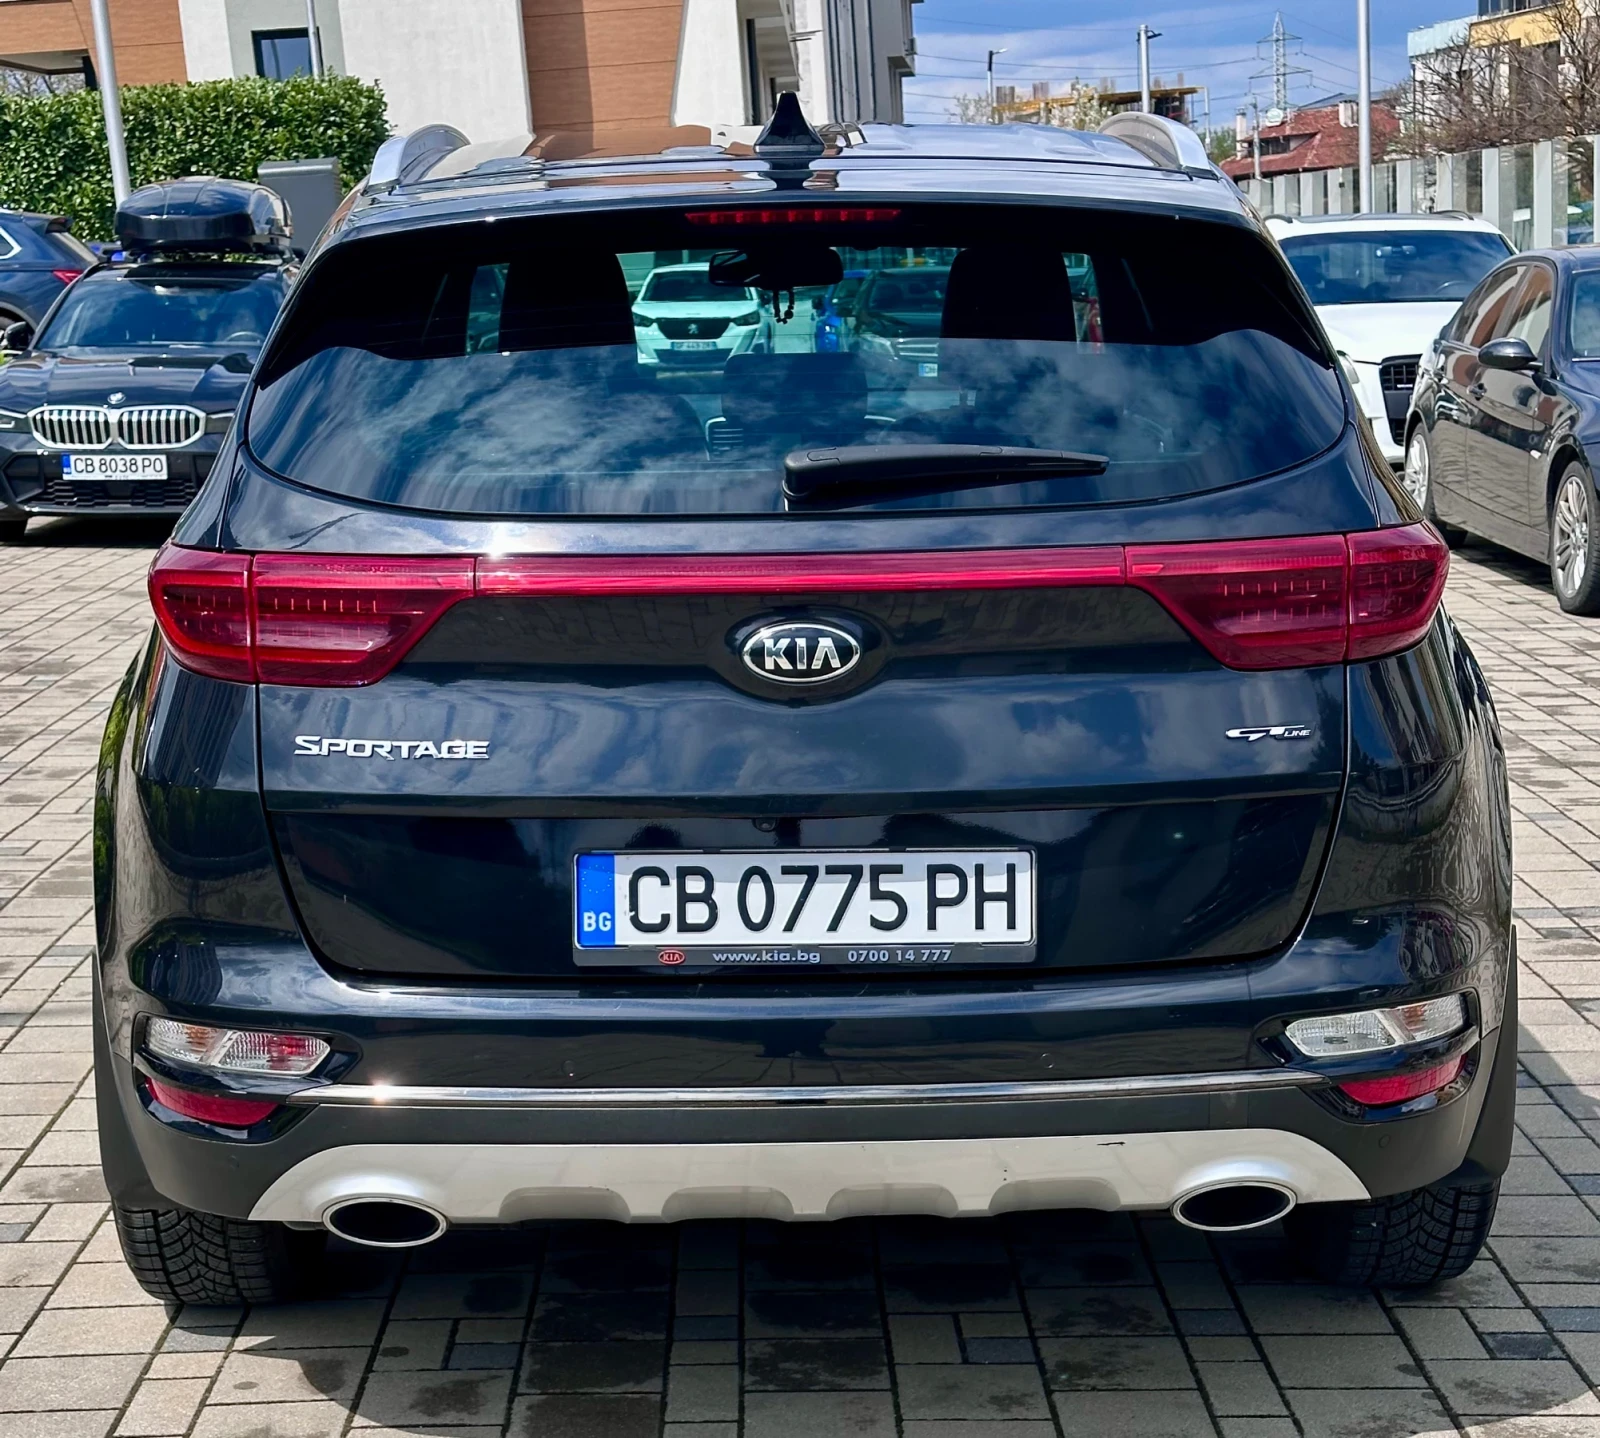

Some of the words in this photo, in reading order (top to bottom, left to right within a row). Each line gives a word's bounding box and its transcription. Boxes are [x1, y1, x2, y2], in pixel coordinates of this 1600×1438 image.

[74, 457, 95, 474] CB
[99, 457, 138, 474] 8038
[141, 457, 163, 474] PO
[763, 637, 841, 670] KIA
[294, 735, 490, 760] SPORTAGE
[629, 865, 718, 933] CB
[737, 864, 908, 932] 0775
[926, 863, 1017, 931] PH
[583, 911, 612, 932] BG
[712, 950, 821, 964] www.kia.bg
[847, 950, 889, 962] 0700
[896, 949, 915, 961] 14
[920, 949, 951, 961] 777
